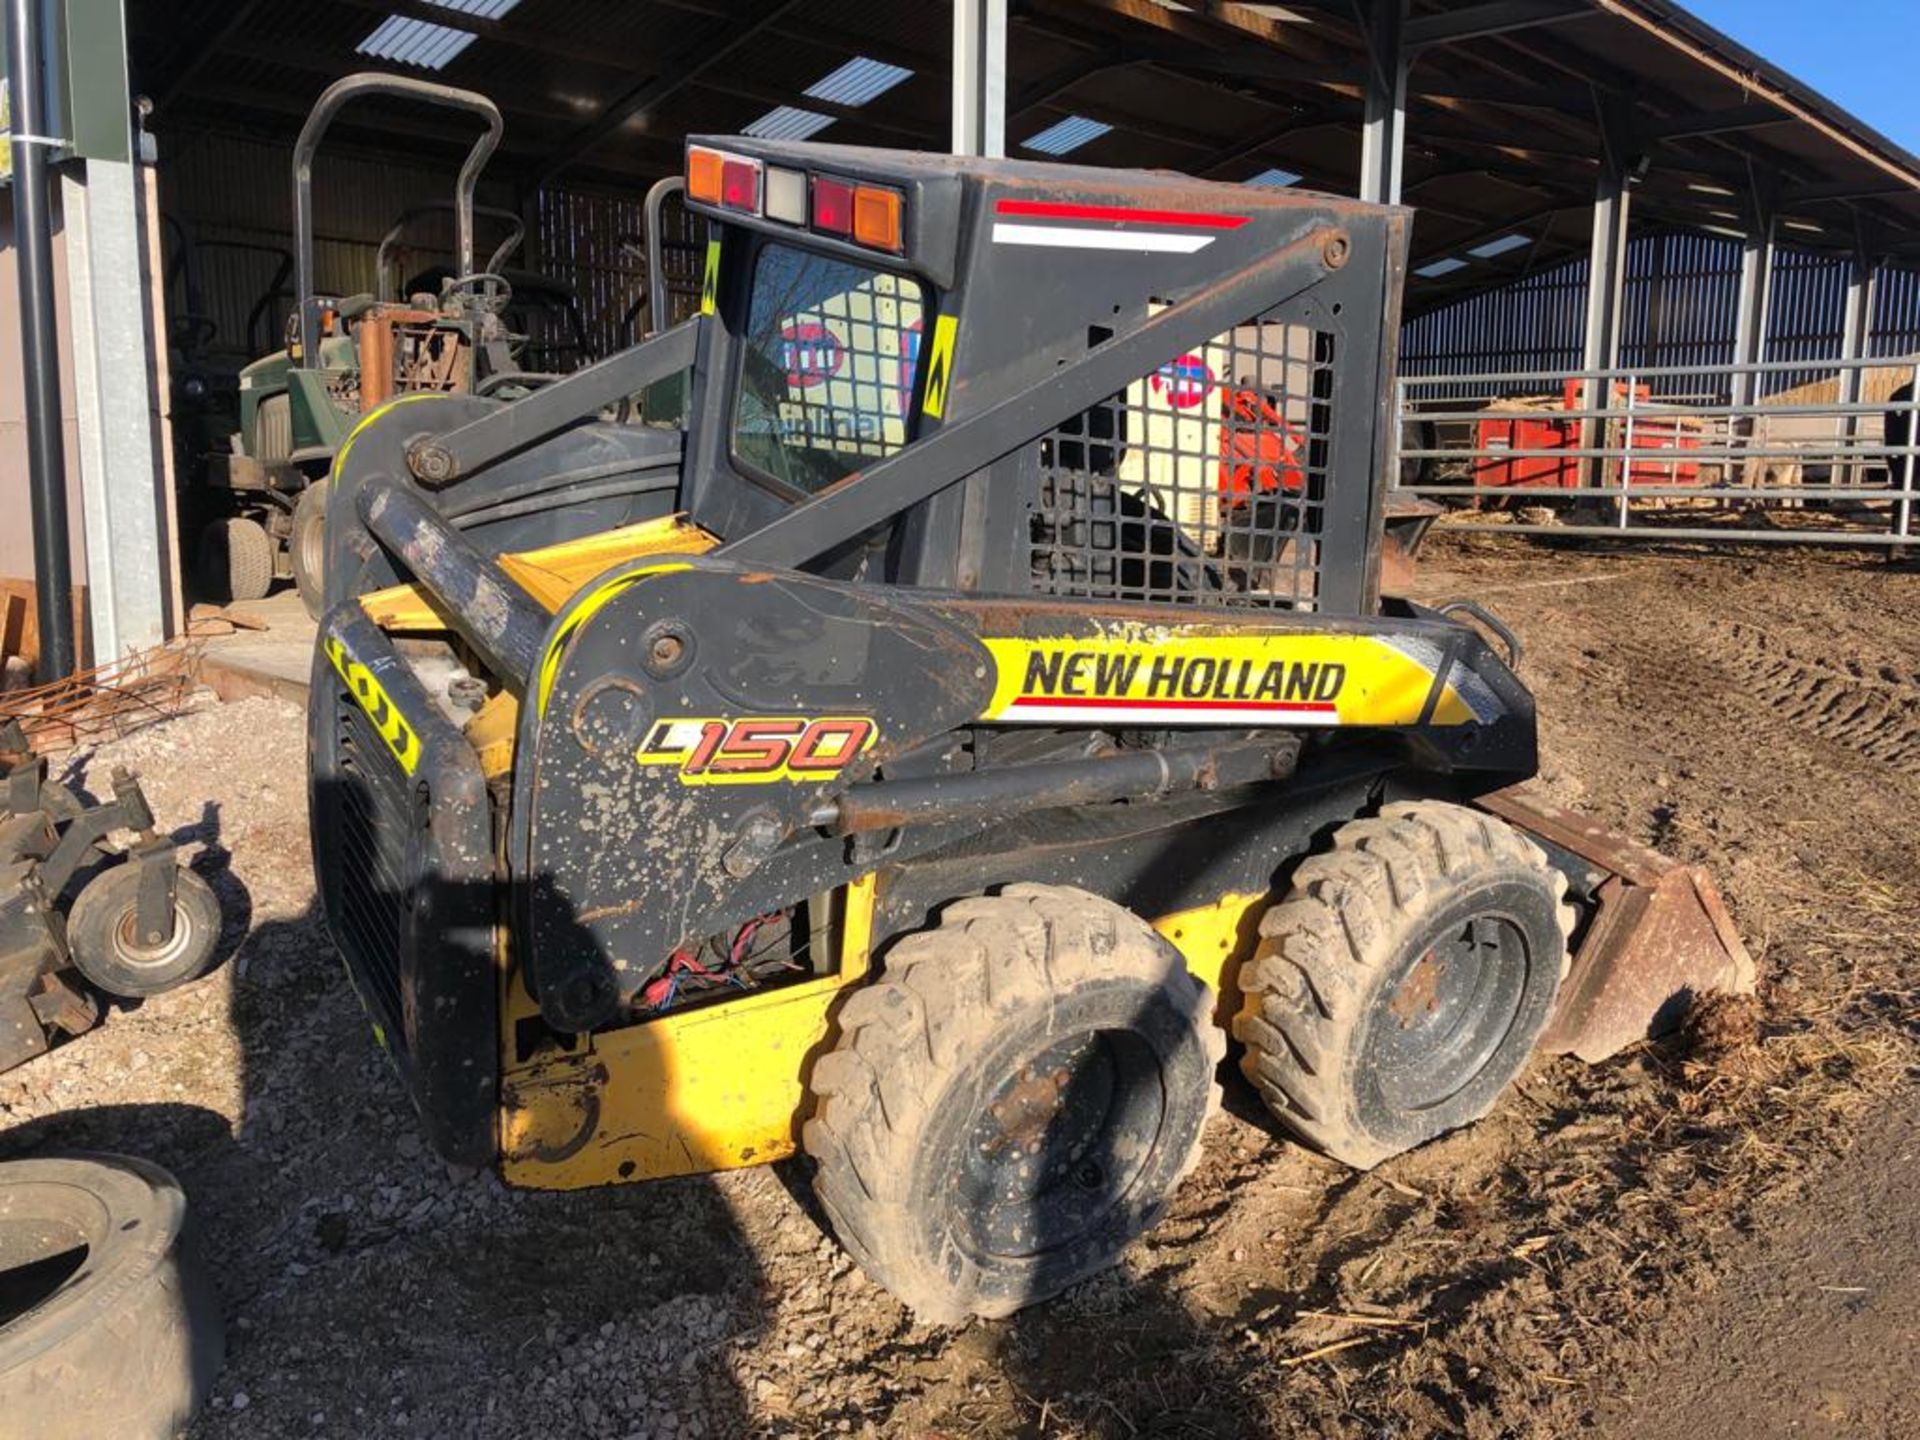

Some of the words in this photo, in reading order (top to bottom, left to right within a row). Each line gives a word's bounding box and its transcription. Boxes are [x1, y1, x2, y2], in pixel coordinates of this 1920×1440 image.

[1022, 650, 1142, 697] NEW
[1147, 655, 1345, 701] HOLLAND
[637, 717, 878, 784] L150
